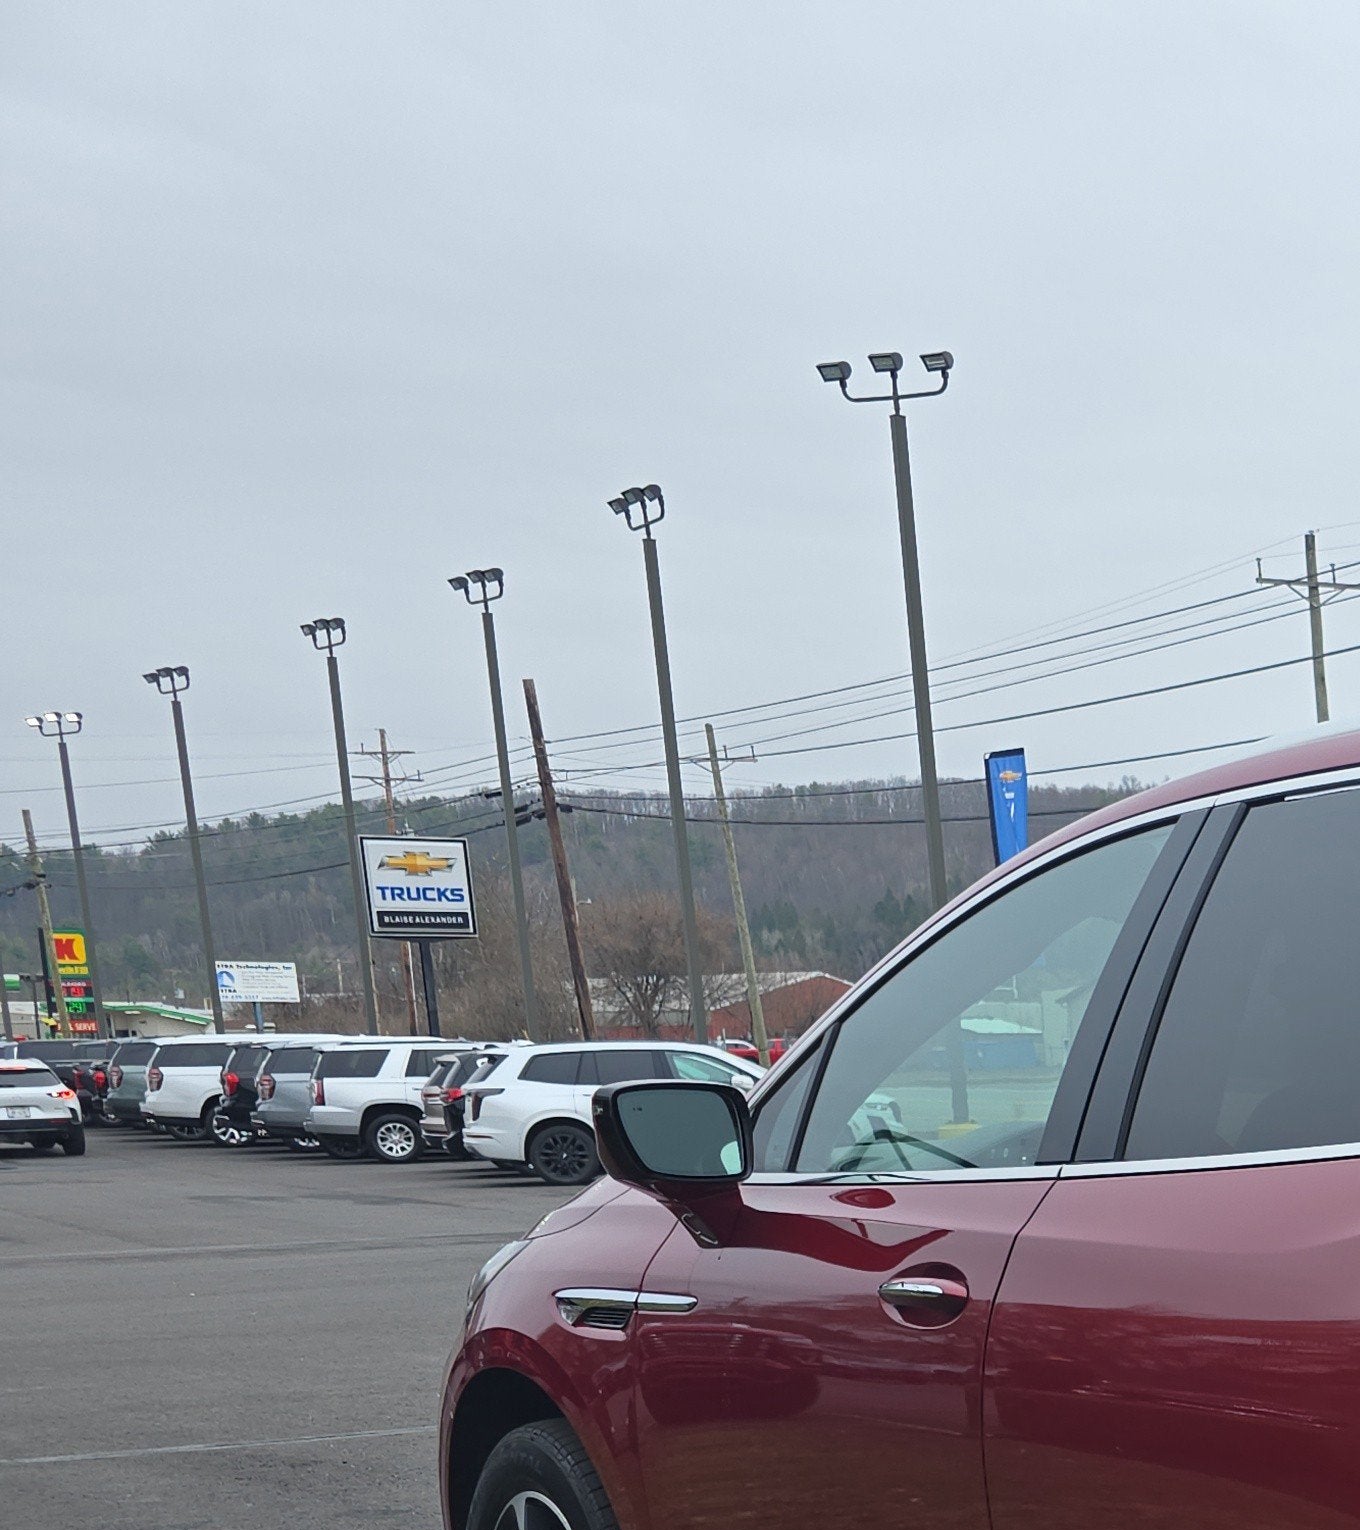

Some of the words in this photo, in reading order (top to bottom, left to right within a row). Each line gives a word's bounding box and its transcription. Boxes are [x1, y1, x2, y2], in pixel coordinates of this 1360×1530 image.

[376, 886, 465, 902] TRUCKS
[384, 915, 414, 923] BLAISE
[415, 915, 464, 924] ALEXANDER
[54, 938, 80, 960] K
